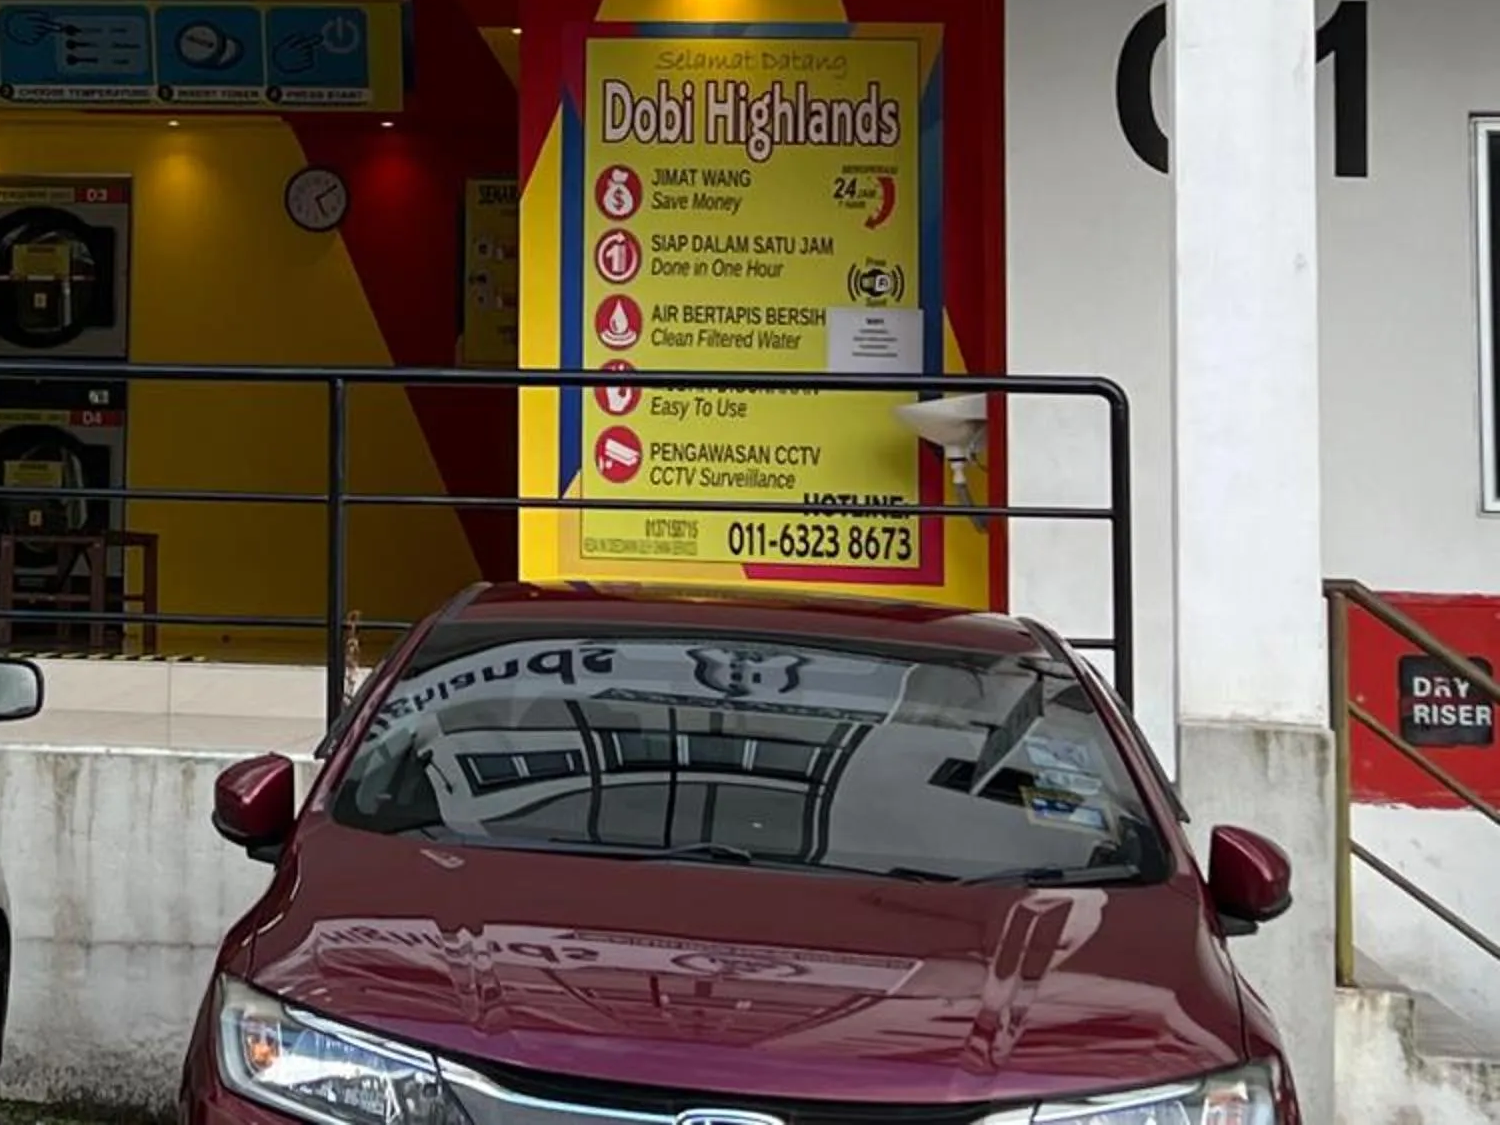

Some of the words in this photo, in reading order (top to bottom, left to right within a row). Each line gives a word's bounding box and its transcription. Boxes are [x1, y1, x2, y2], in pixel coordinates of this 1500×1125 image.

[654, 50, 752, 72] Selamat
[760, 51, 847, 79] Datang
[602, 79, 696, 144] Dobi
[704, 79, 900, 163] Highlands
[652, 169, 697, 187] JIMAT
[702, 169, 751, 188] WANG
[834, 177, 857, 199] 24
[652, 191, 688, 210] Save
[692, 191, 742, 215] Money
[652, 235, 688, 253] SIAP
[692, 235, 748, 254] DALAM
[752, 235, 795, 255] SATU
[800, 236, 834, 255] JAM
[652, 258, 689, 275] Done
[694, 259, 706, 275] in
[711, 259, 742, 276] One
[746, 260, 785, 277] Hour
[652, 305, 678, 323] AIR
[683, 305, 761, 325] BERTAPIS
[766, 307, 826, 325] BERSIH
[652, 328, 693, 347] Clean
[697, 329, 752, 349] Filtered
[758, 331, 801, 350] Water
[651, 397, 690, 420] Easy
[695, 398, 713, 416] To
[717, 399, 747, 418] Use
[650, 443, 770, 464] PENGAWASAN
[776, 445, 820, 466] CCTV
[650, 467, 696, 486] CCTV
[700, 468, 796, 489] Surveillance
[728, 522, 840, 559] 011-6323
[849, 526, 912, 562] 8673
[1411, 676, 1470, 699] DRY
[1412, 704, 1493, 727] RISER
